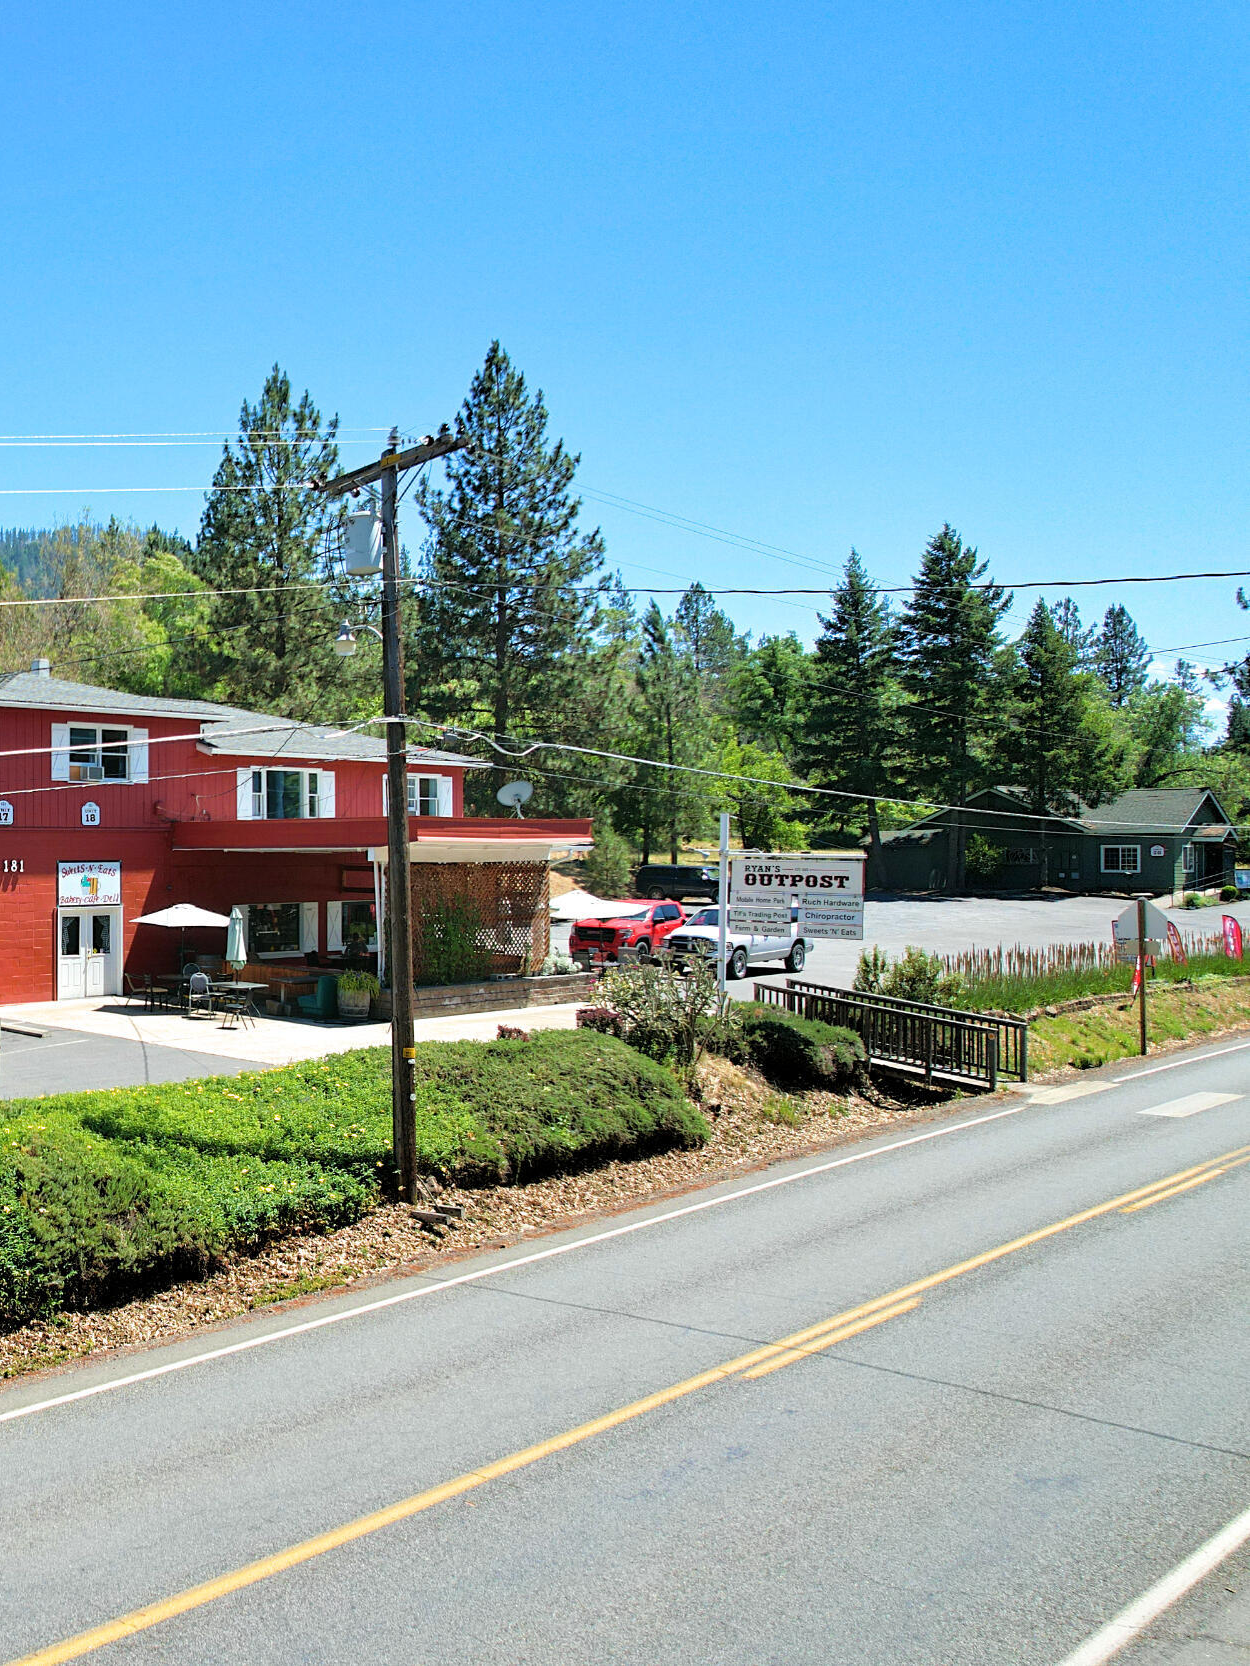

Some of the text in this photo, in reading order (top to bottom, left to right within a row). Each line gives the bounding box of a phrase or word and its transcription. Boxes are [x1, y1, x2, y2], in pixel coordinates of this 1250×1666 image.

[85, 813, 95, 822] 18
[3, 859, 25, 873] 181
[744, 864, 781, 873] RYAN'S
[743, 873, 850, 889] OUTPOST
[801, 898, 860, 907] Ruch Hardware
[748, 911, 772, 920] Trading
[804, 911, 855, 921] Chiropractor
[761, 925, 785, 933] Garden
[803, 926, 829, 935] Sweets
[840, 928, 857, 936] Eats
